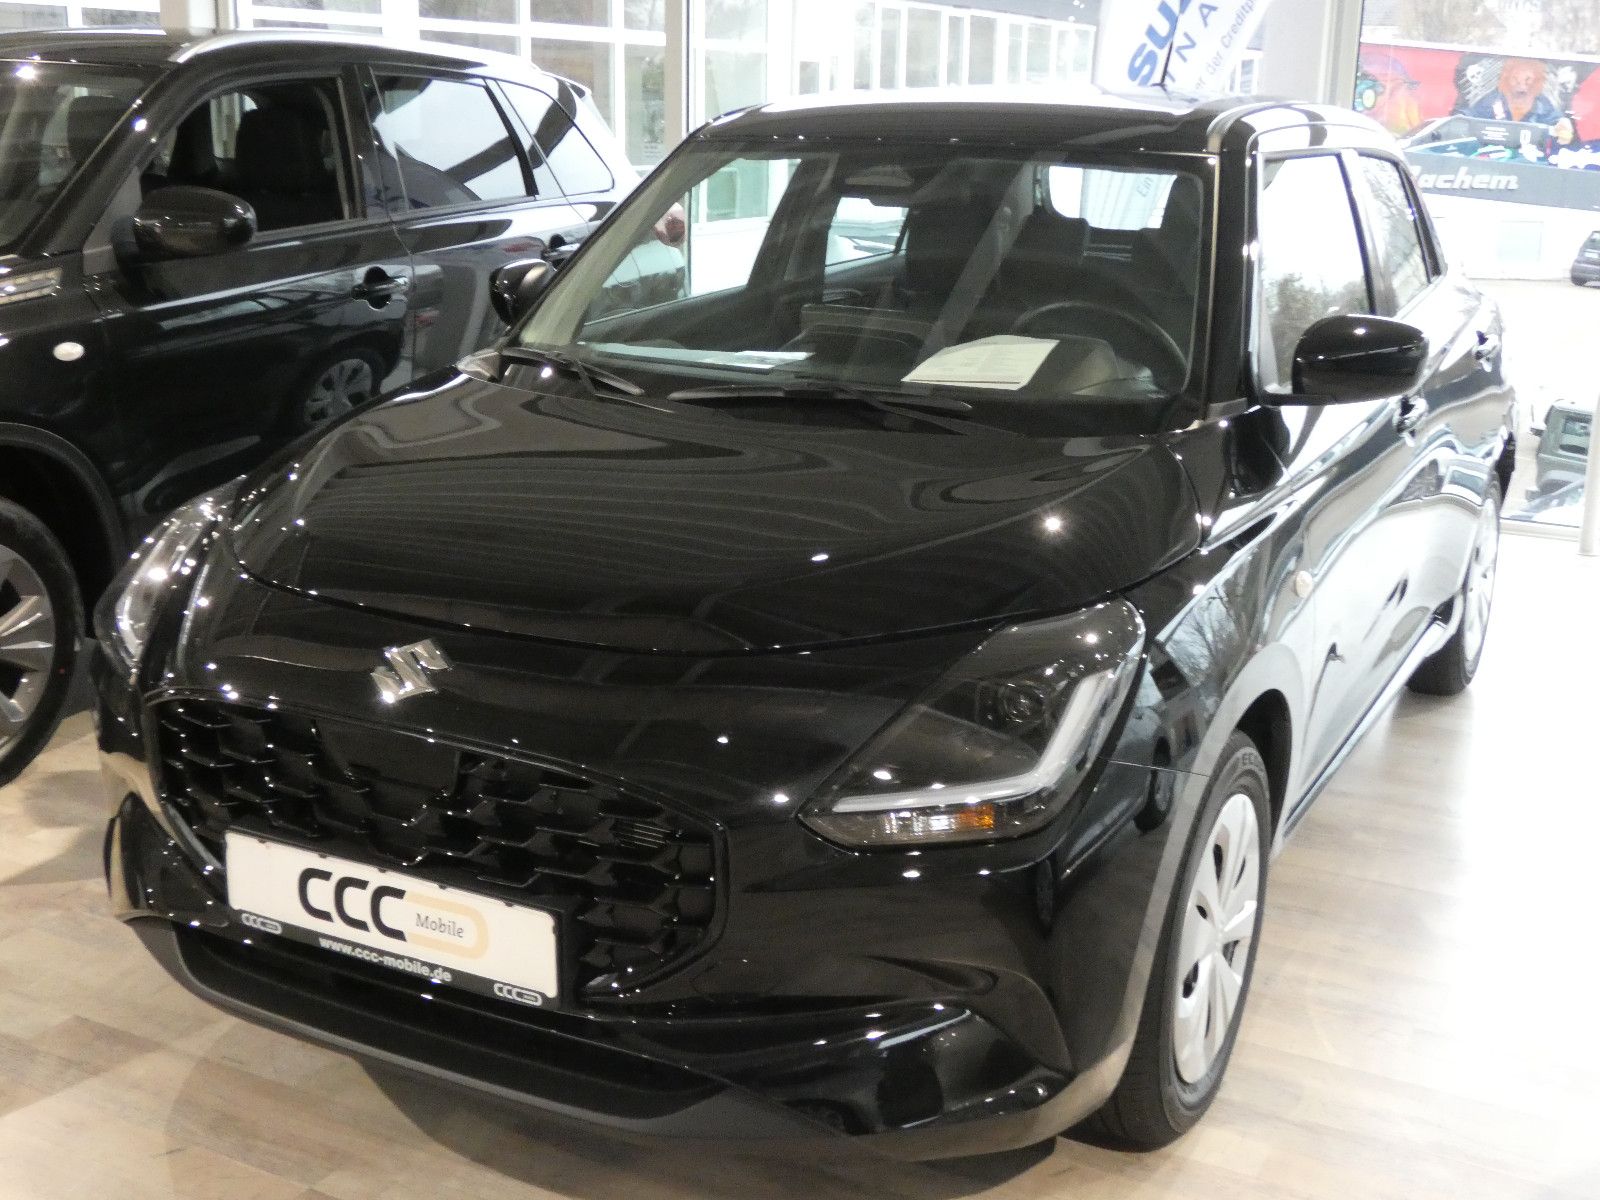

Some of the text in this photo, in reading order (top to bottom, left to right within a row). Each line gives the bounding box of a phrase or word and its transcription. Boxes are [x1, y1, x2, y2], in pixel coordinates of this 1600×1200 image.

[1128, 0, 1191, 86] SU
[1207, 51, 1224, 76] der
[298, 867, 465, 942] CCC Mobile
[318, 937, 452, 983] www.ccc-mobile.de
